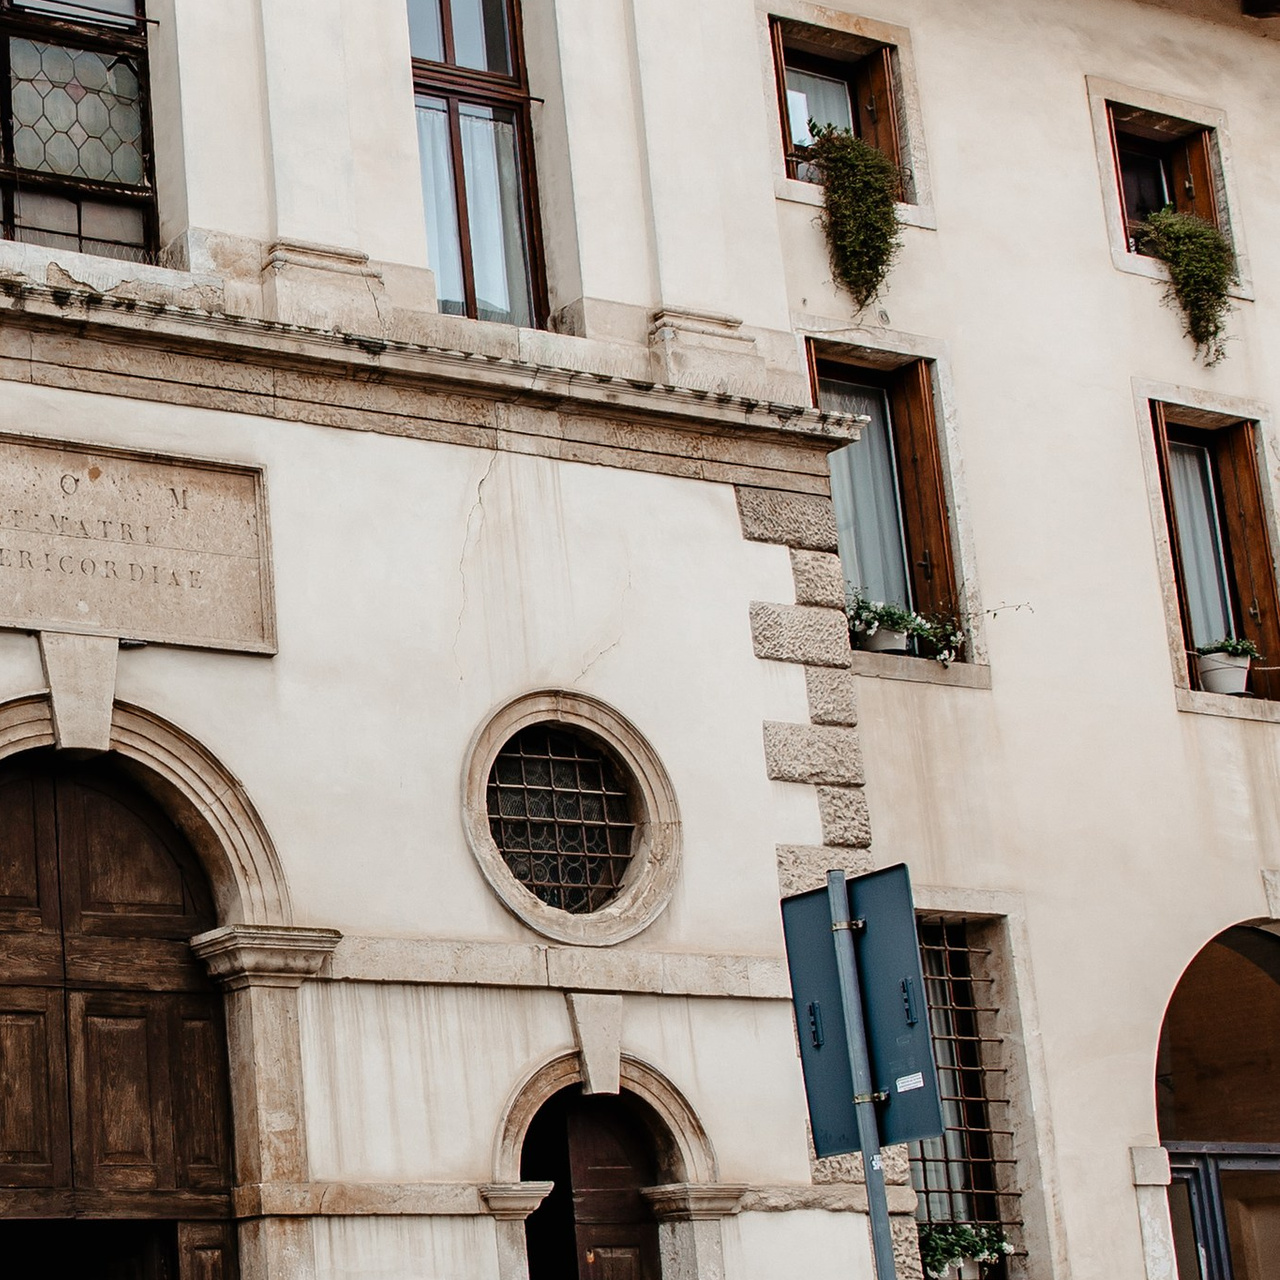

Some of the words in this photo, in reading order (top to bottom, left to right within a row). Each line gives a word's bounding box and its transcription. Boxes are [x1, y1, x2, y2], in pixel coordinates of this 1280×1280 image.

[60, 473, 79, 496] O
[169, 487, 190, 511] M
[49, 513, 156, 544] MATRI
